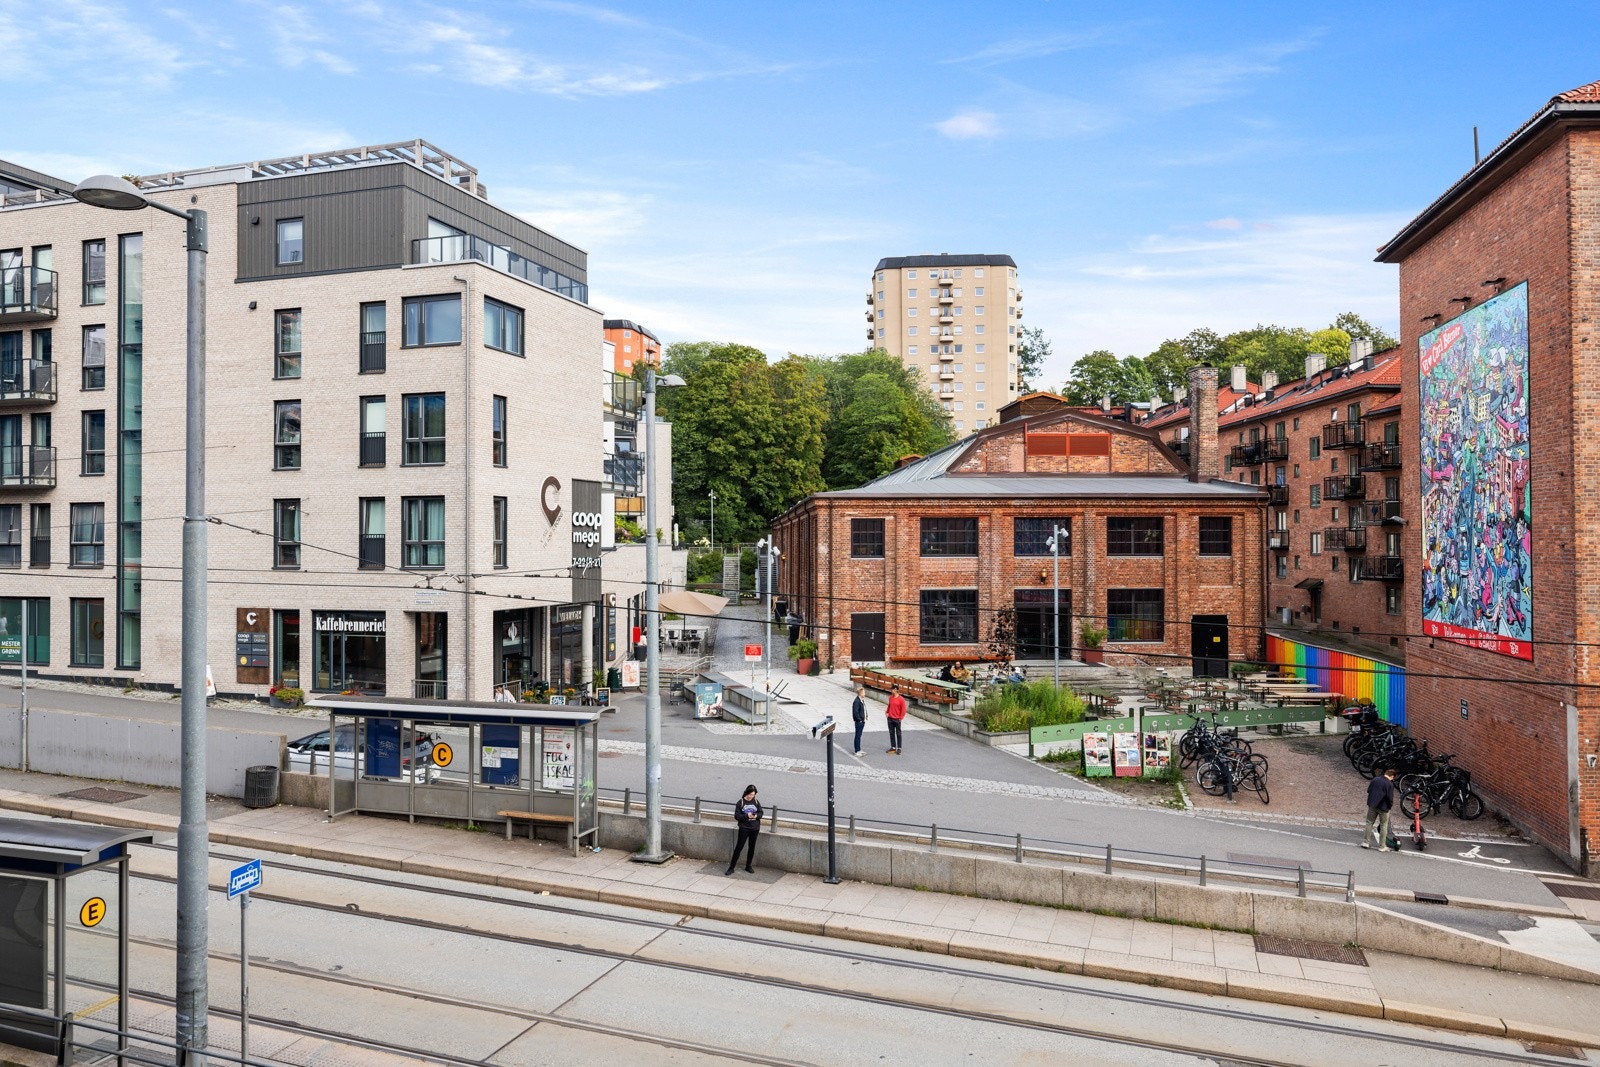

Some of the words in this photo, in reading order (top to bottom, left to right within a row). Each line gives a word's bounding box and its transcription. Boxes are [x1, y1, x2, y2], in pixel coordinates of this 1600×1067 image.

[573, 512, 602, 530] coop
[573, 531, 600, 547] mega
[316, 617, 386, 632] Kaffebrenneriet
[437, 747, 447, 762] C
[88, 902, 99, 922] E
